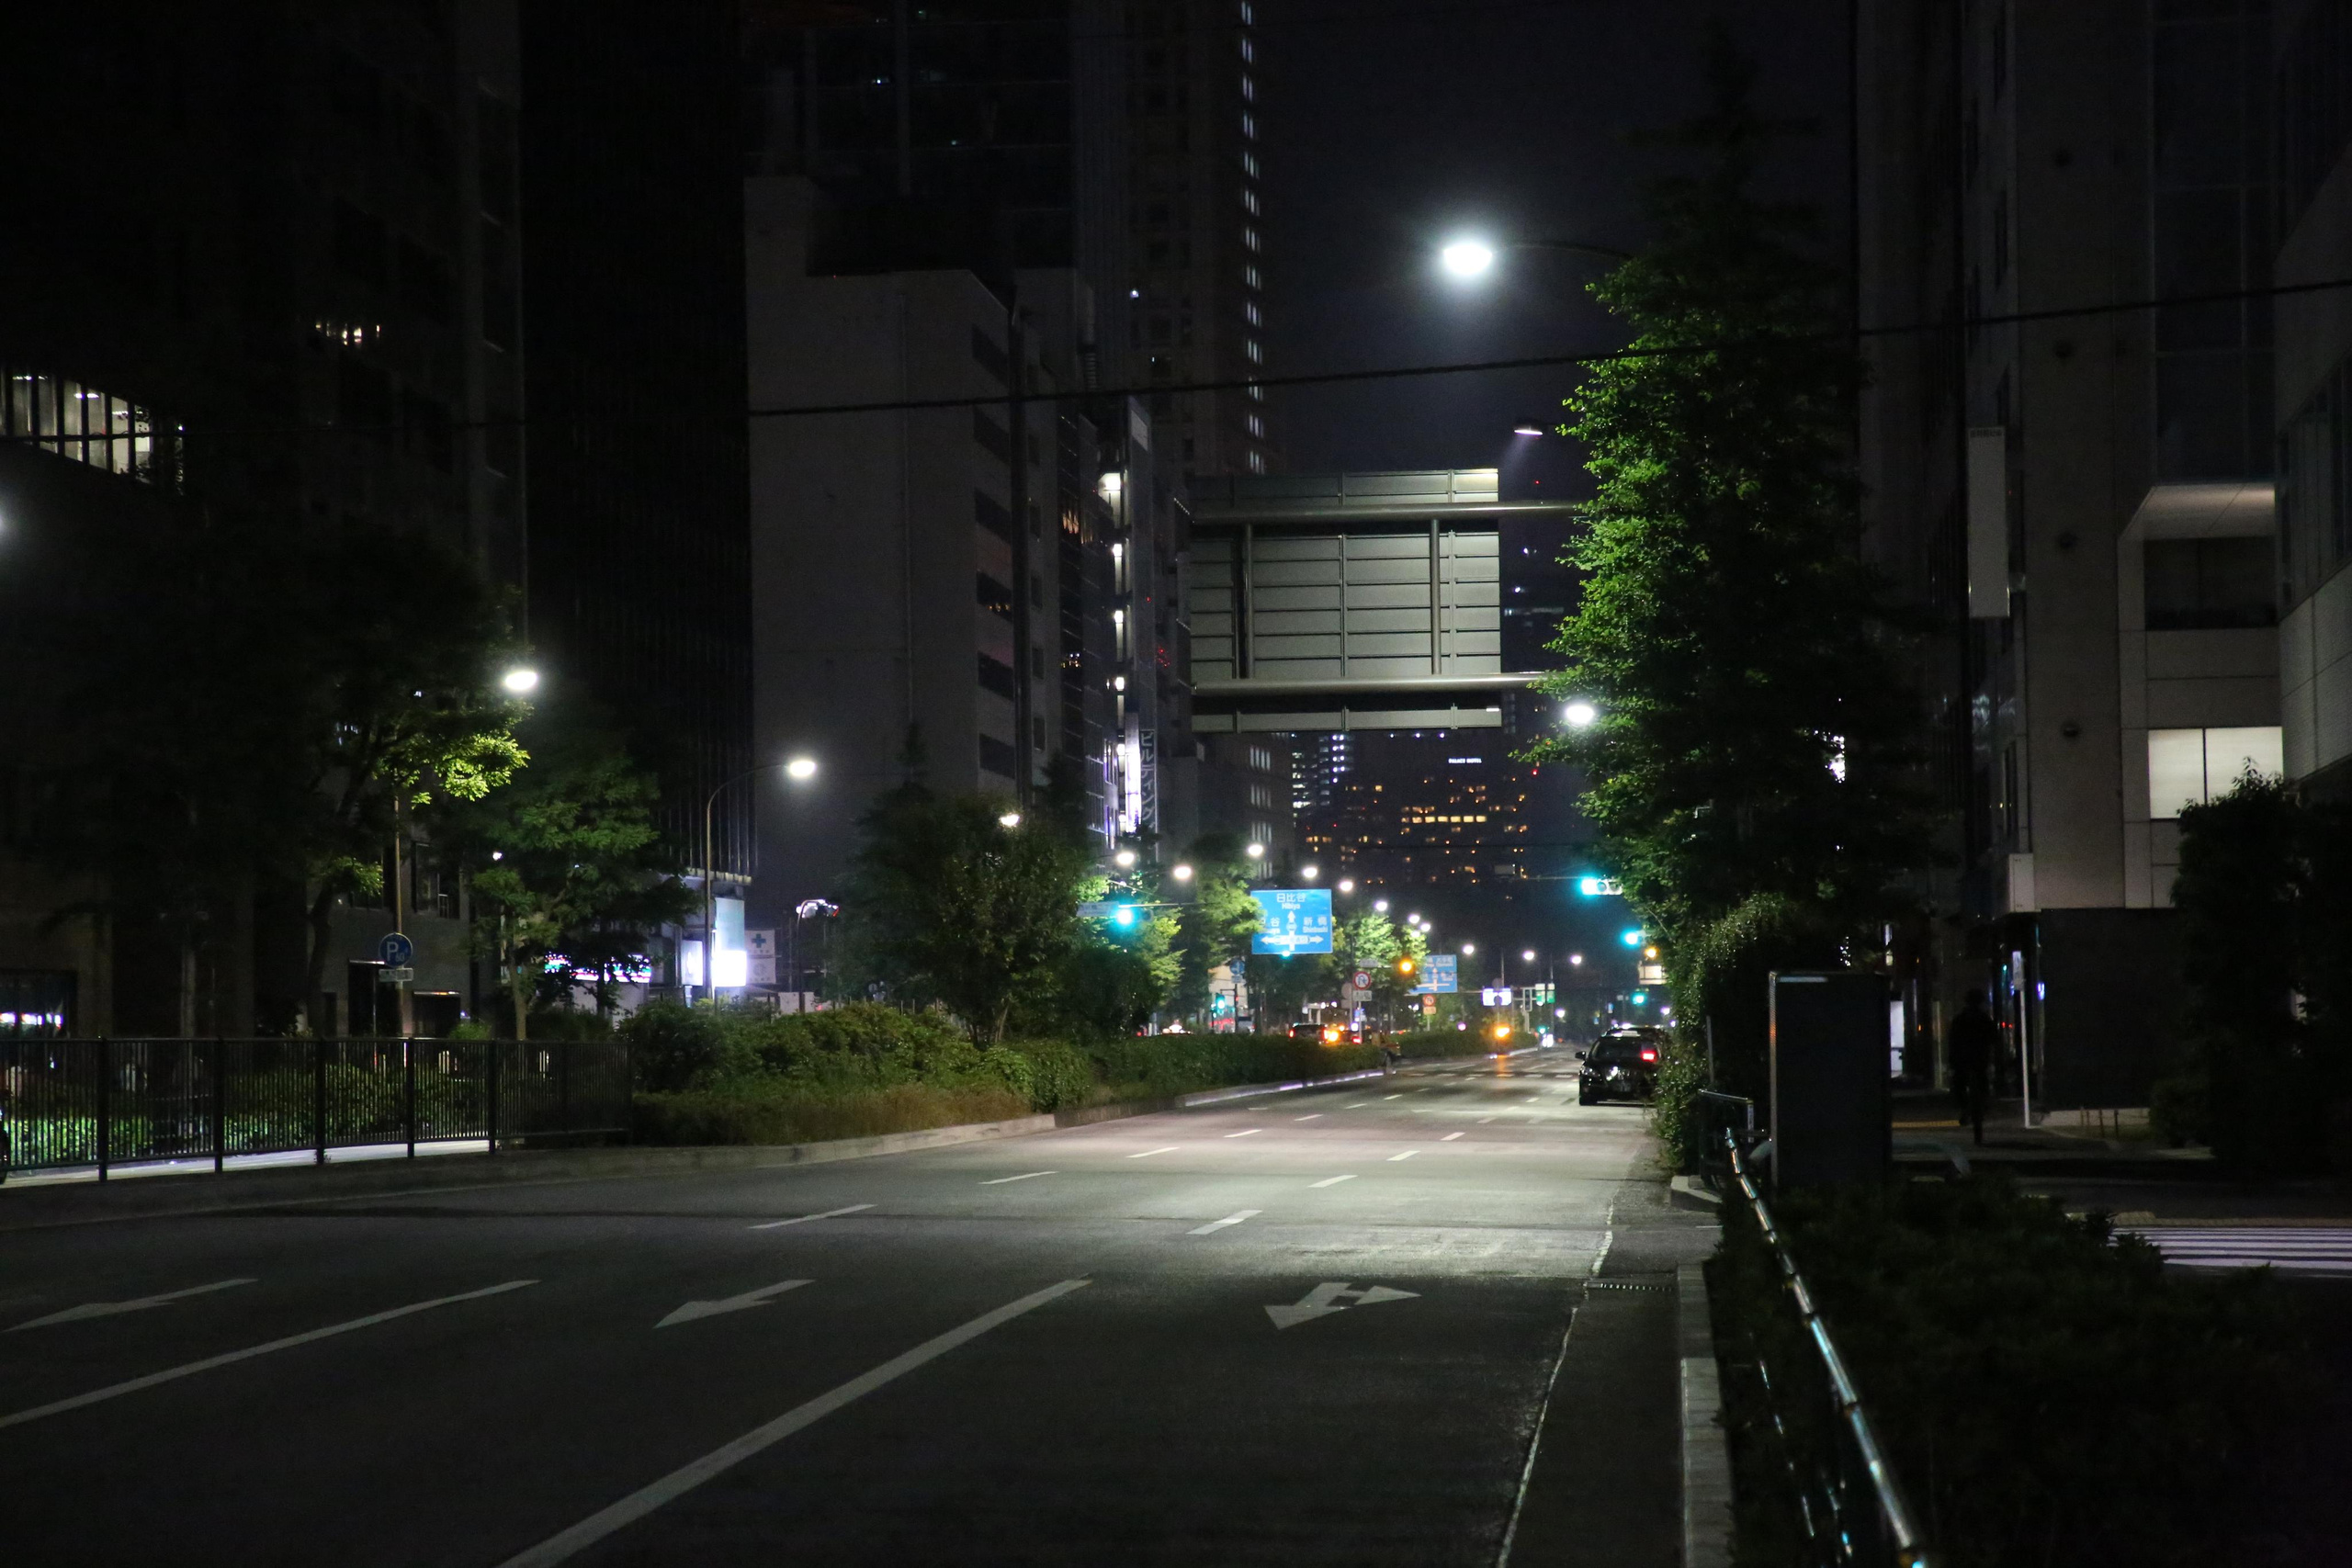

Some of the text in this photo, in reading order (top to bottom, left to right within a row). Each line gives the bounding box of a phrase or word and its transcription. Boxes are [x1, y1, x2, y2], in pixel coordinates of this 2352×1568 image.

[1277, 893, 1306, 902] 日比谷
[387, 942, 399, 961] P
